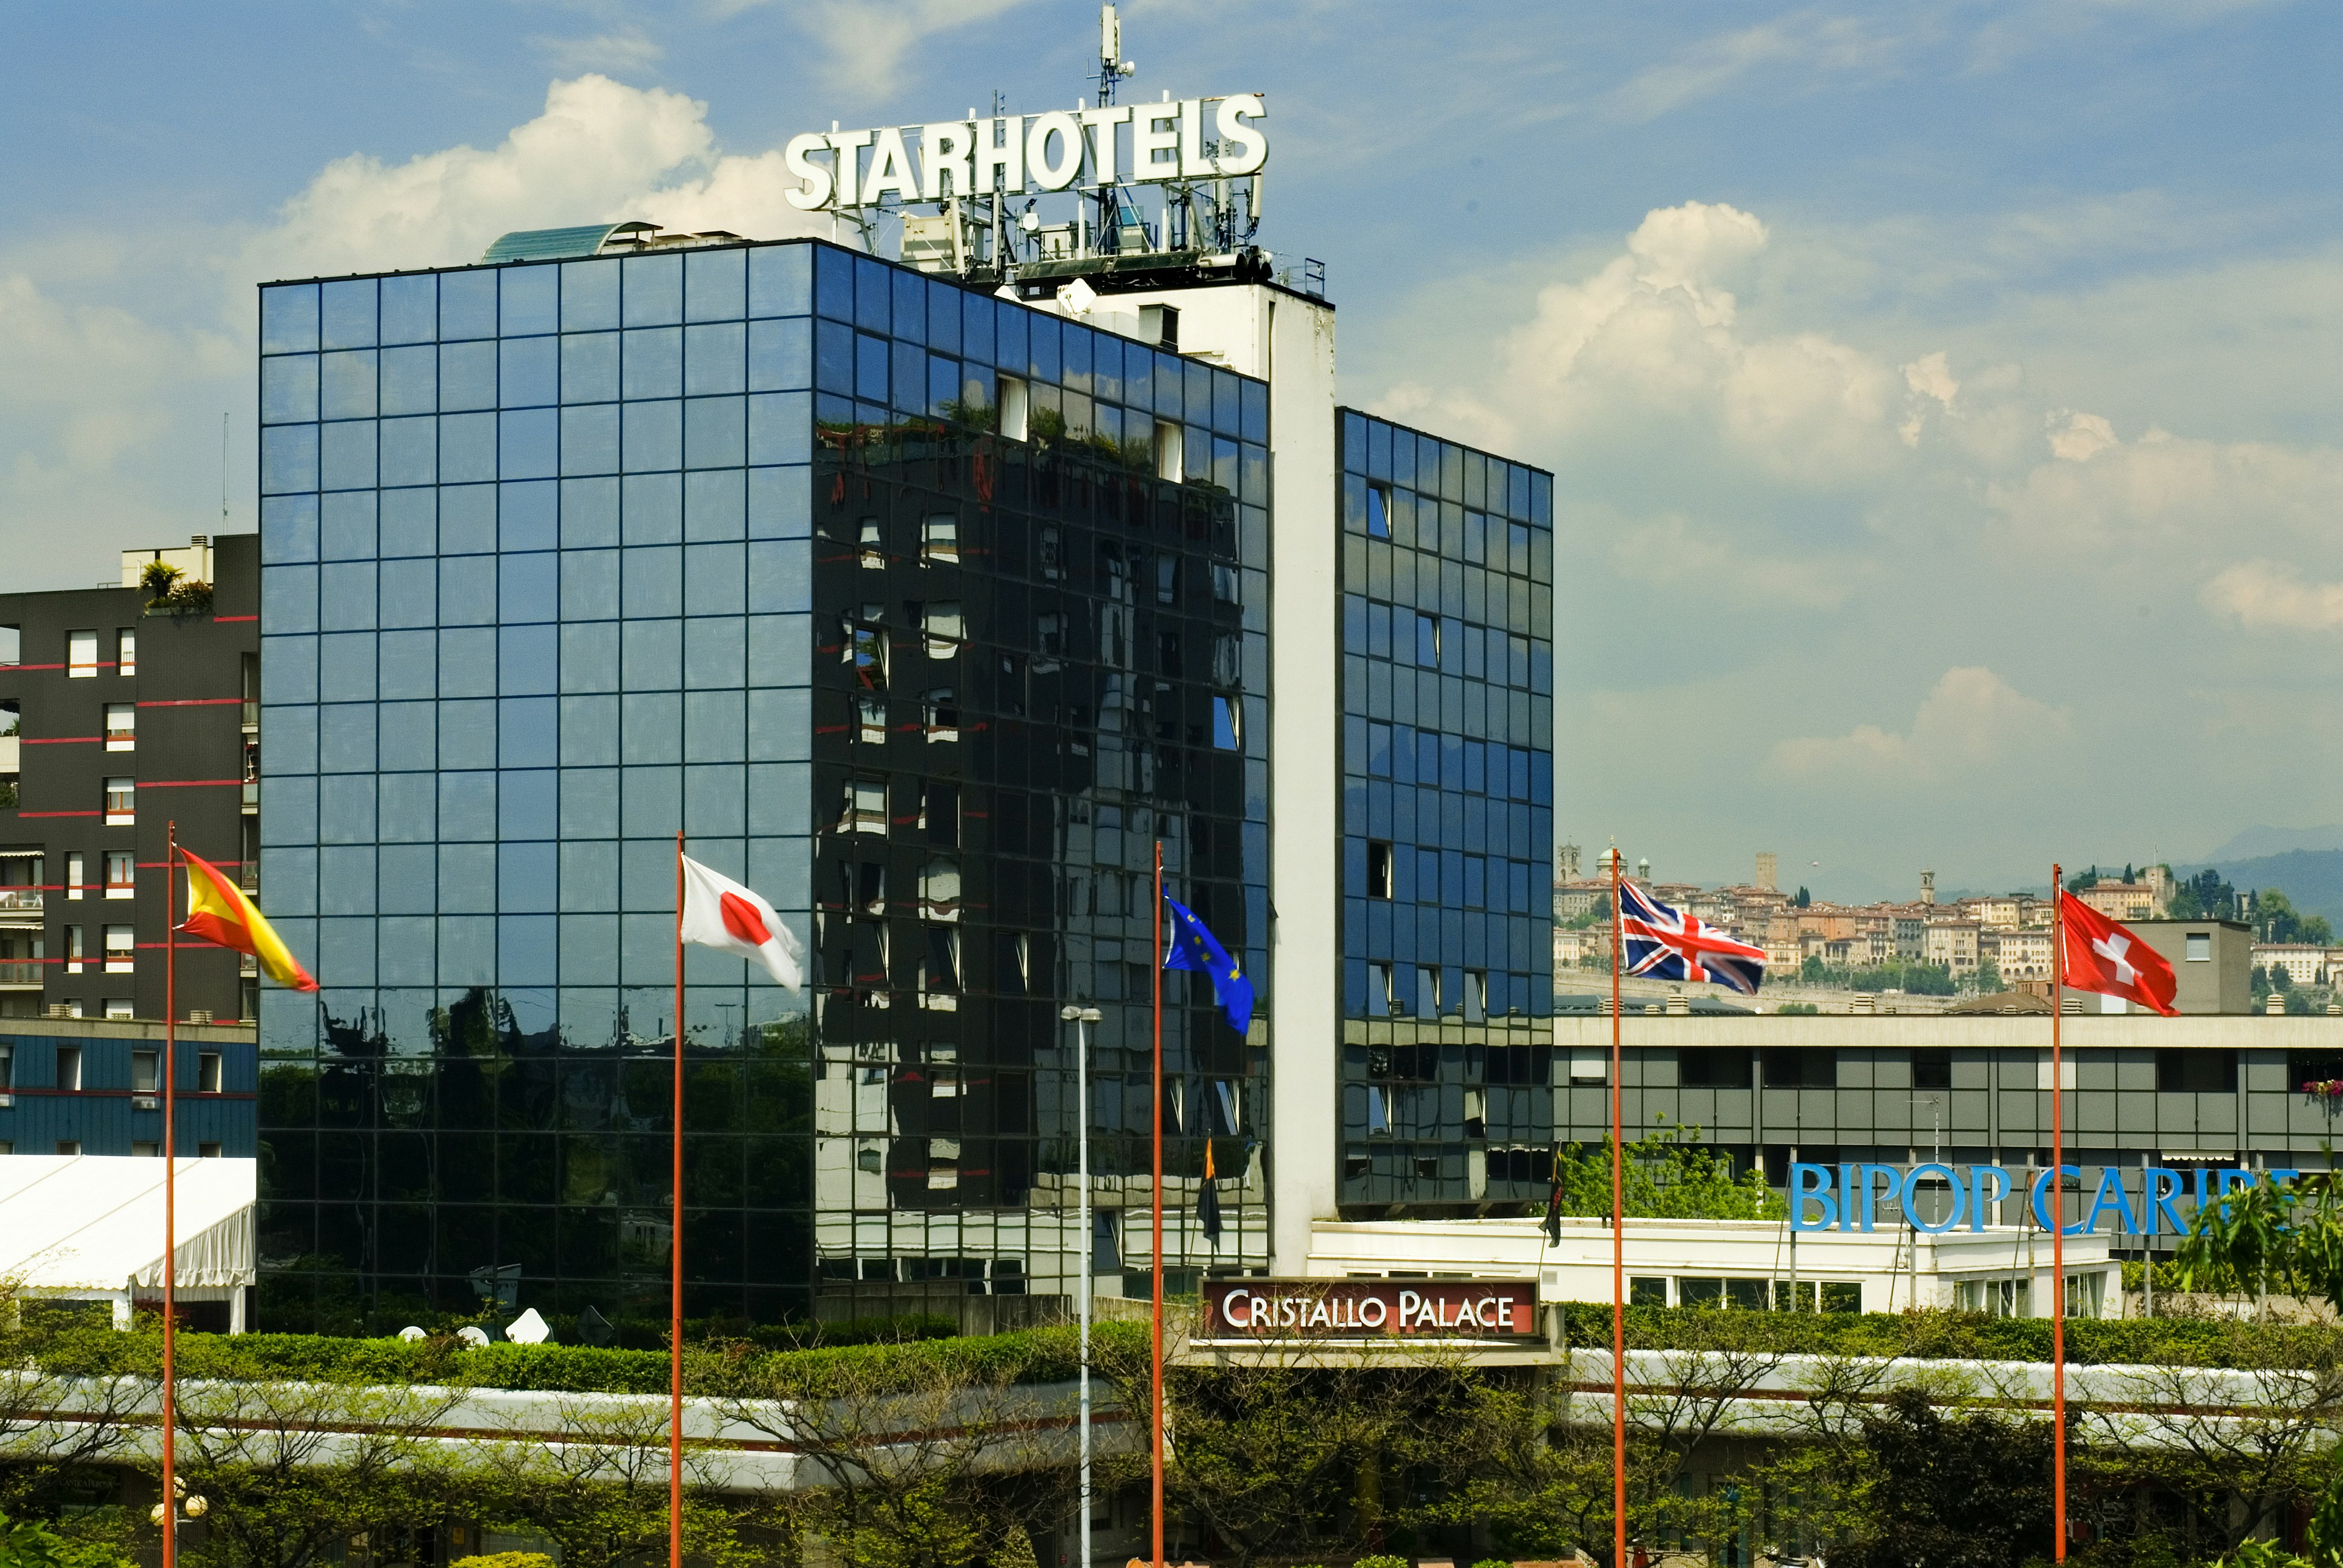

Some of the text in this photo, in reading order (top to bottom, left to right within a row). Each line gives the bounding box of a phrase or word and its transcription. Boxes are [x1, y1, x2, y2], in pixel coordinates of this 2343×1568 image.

[784, 94, 1269, 211] STARHOTELS
[1789, 1163, 2012, 1234] BIPOP
[1222, 1289, 1514, 1328] CRISTALLO PALACE
